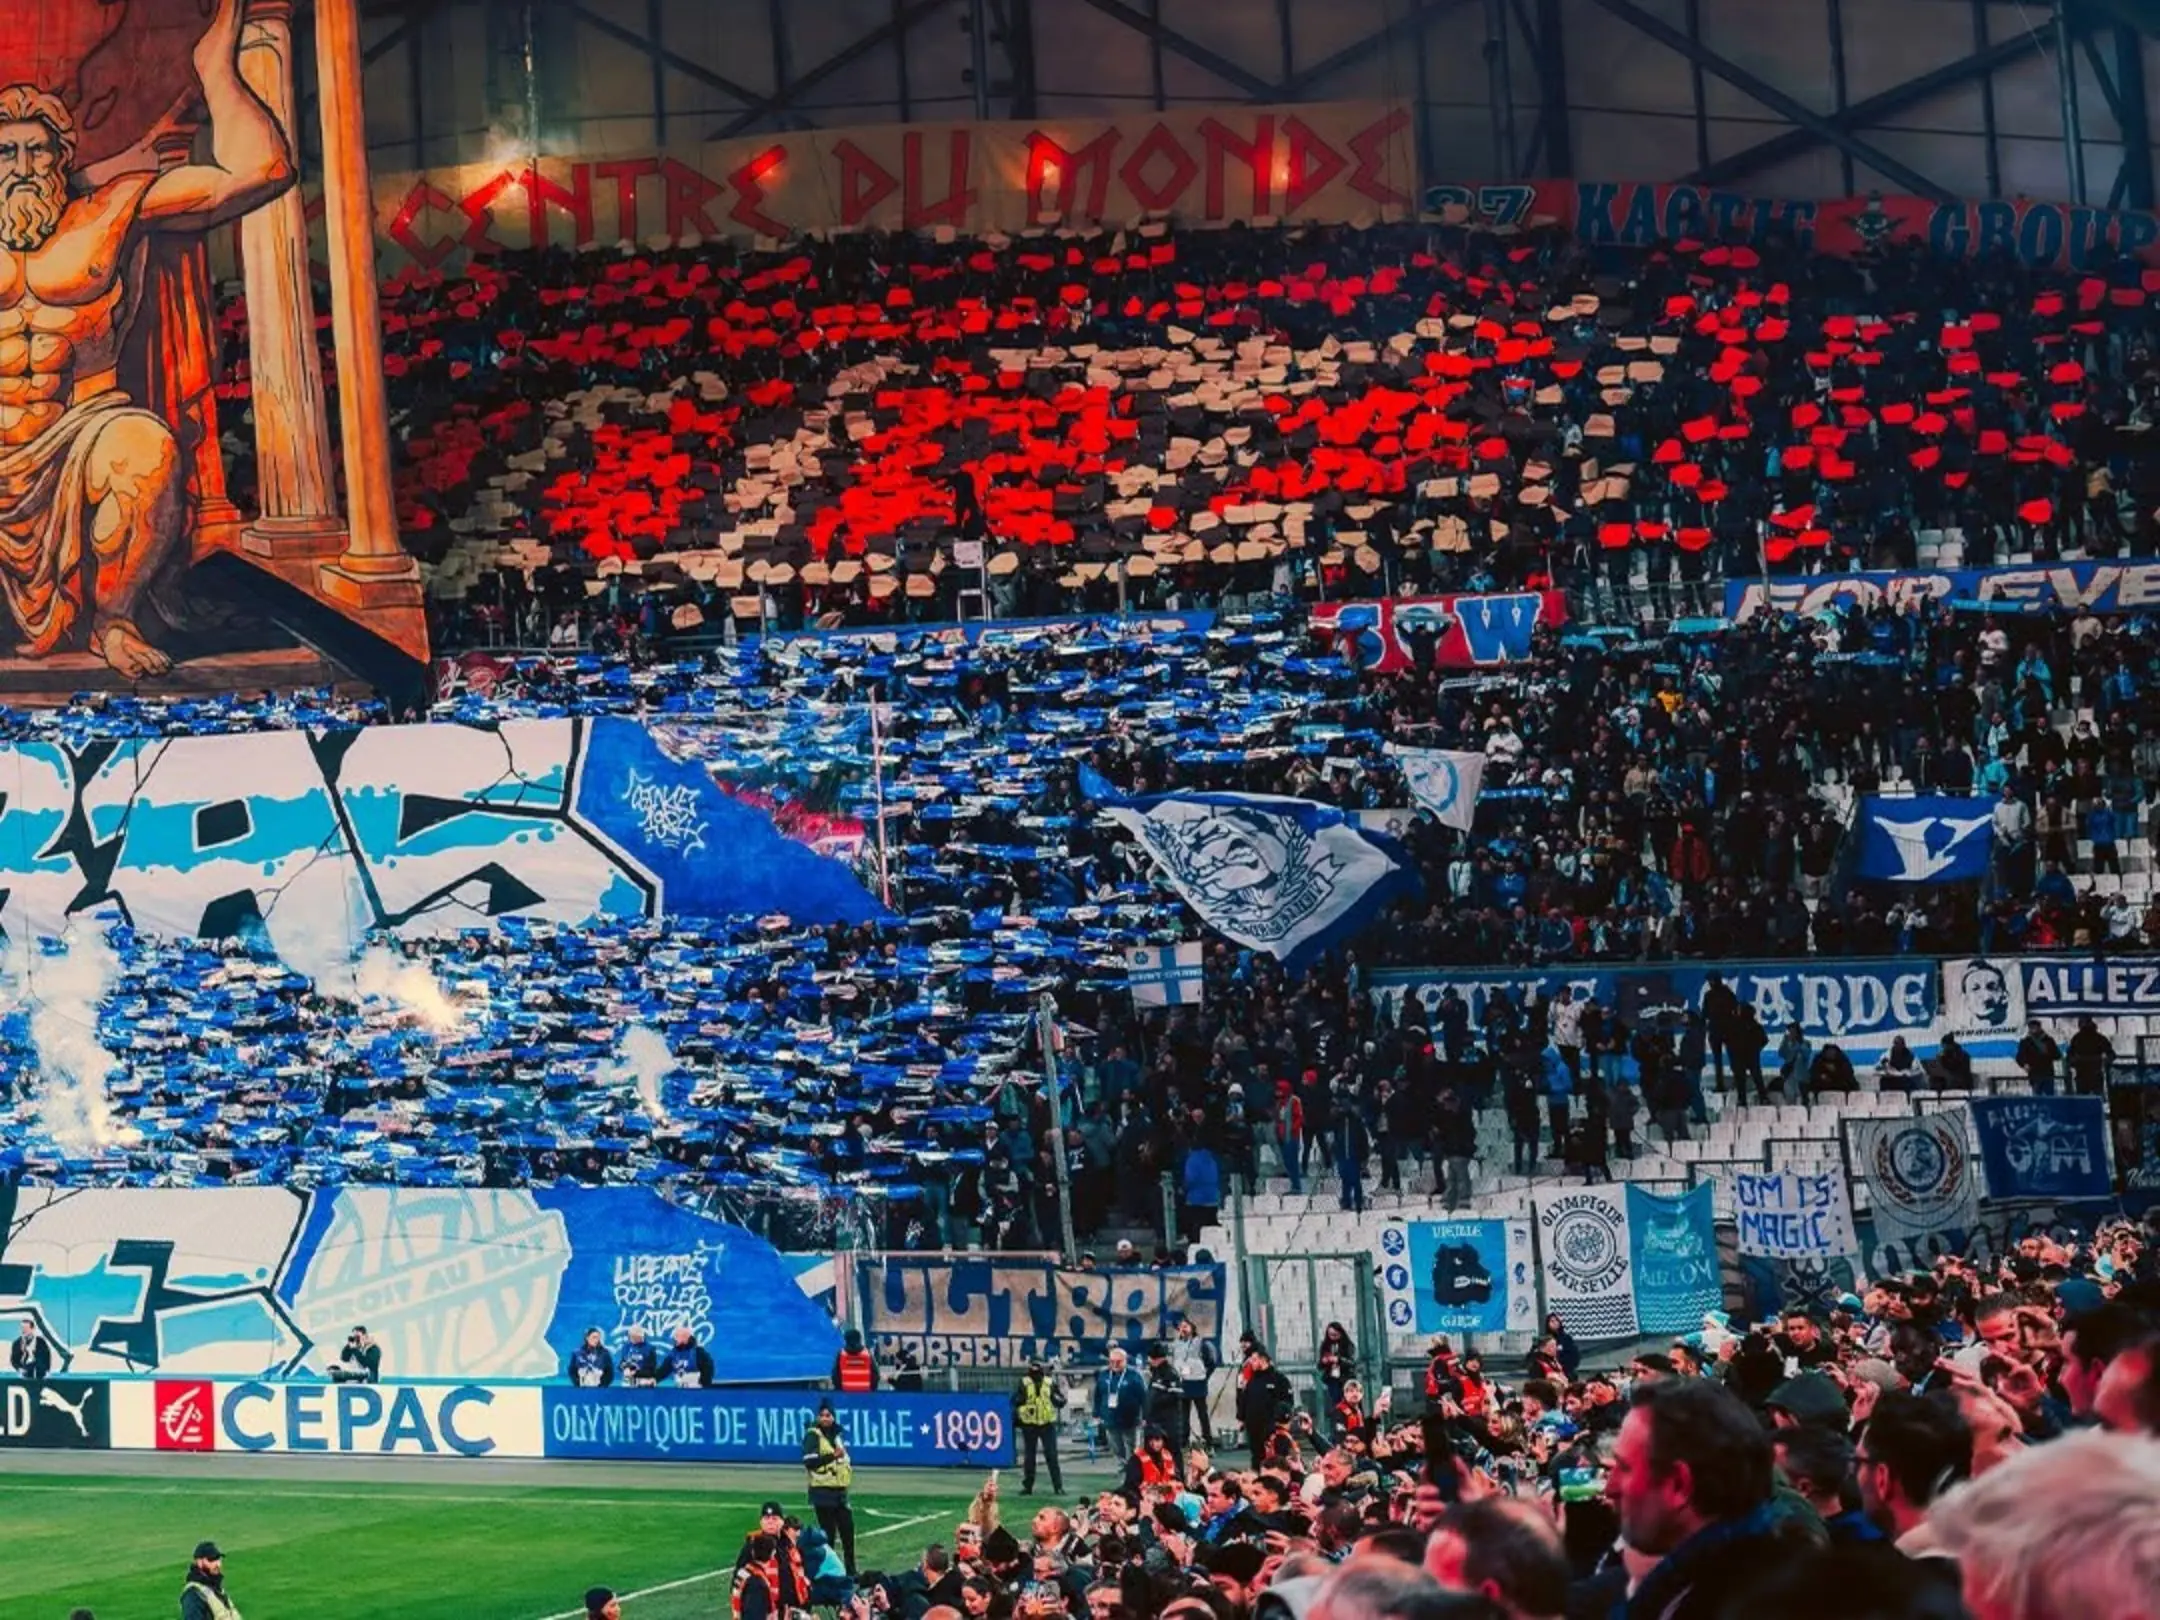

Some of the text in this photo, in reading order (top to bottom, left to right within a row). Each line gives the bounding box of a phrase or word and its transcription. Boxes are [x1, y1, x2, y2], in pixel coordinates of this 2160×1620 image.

[389, 144, 795, 267] CENTRE
[832, 130, 977, 229] DU
[1022, 108, 1411, 223] MONDE
[1699, 972, 1928, 1036] ARDE
[2027, 966, 2160, 1003] ALLEZ
[1738, 1174, 1783, 1208] OM
[1541, 1195, 1624, 1228] OLYMPIQUE
[1741, 1210, 1832, 1248] MAGIC
[426, 1261, 470, 1292] AU
[1547, 1255, 1628, 1294] MARSEILLE
[868, 1266, 1217, 1339] ULTRAS
[222, 1382, 496, 1456] CEPAC
[553, 1403, 1002, 1452] OLYMPIQUE DE MAREILLE 1899
